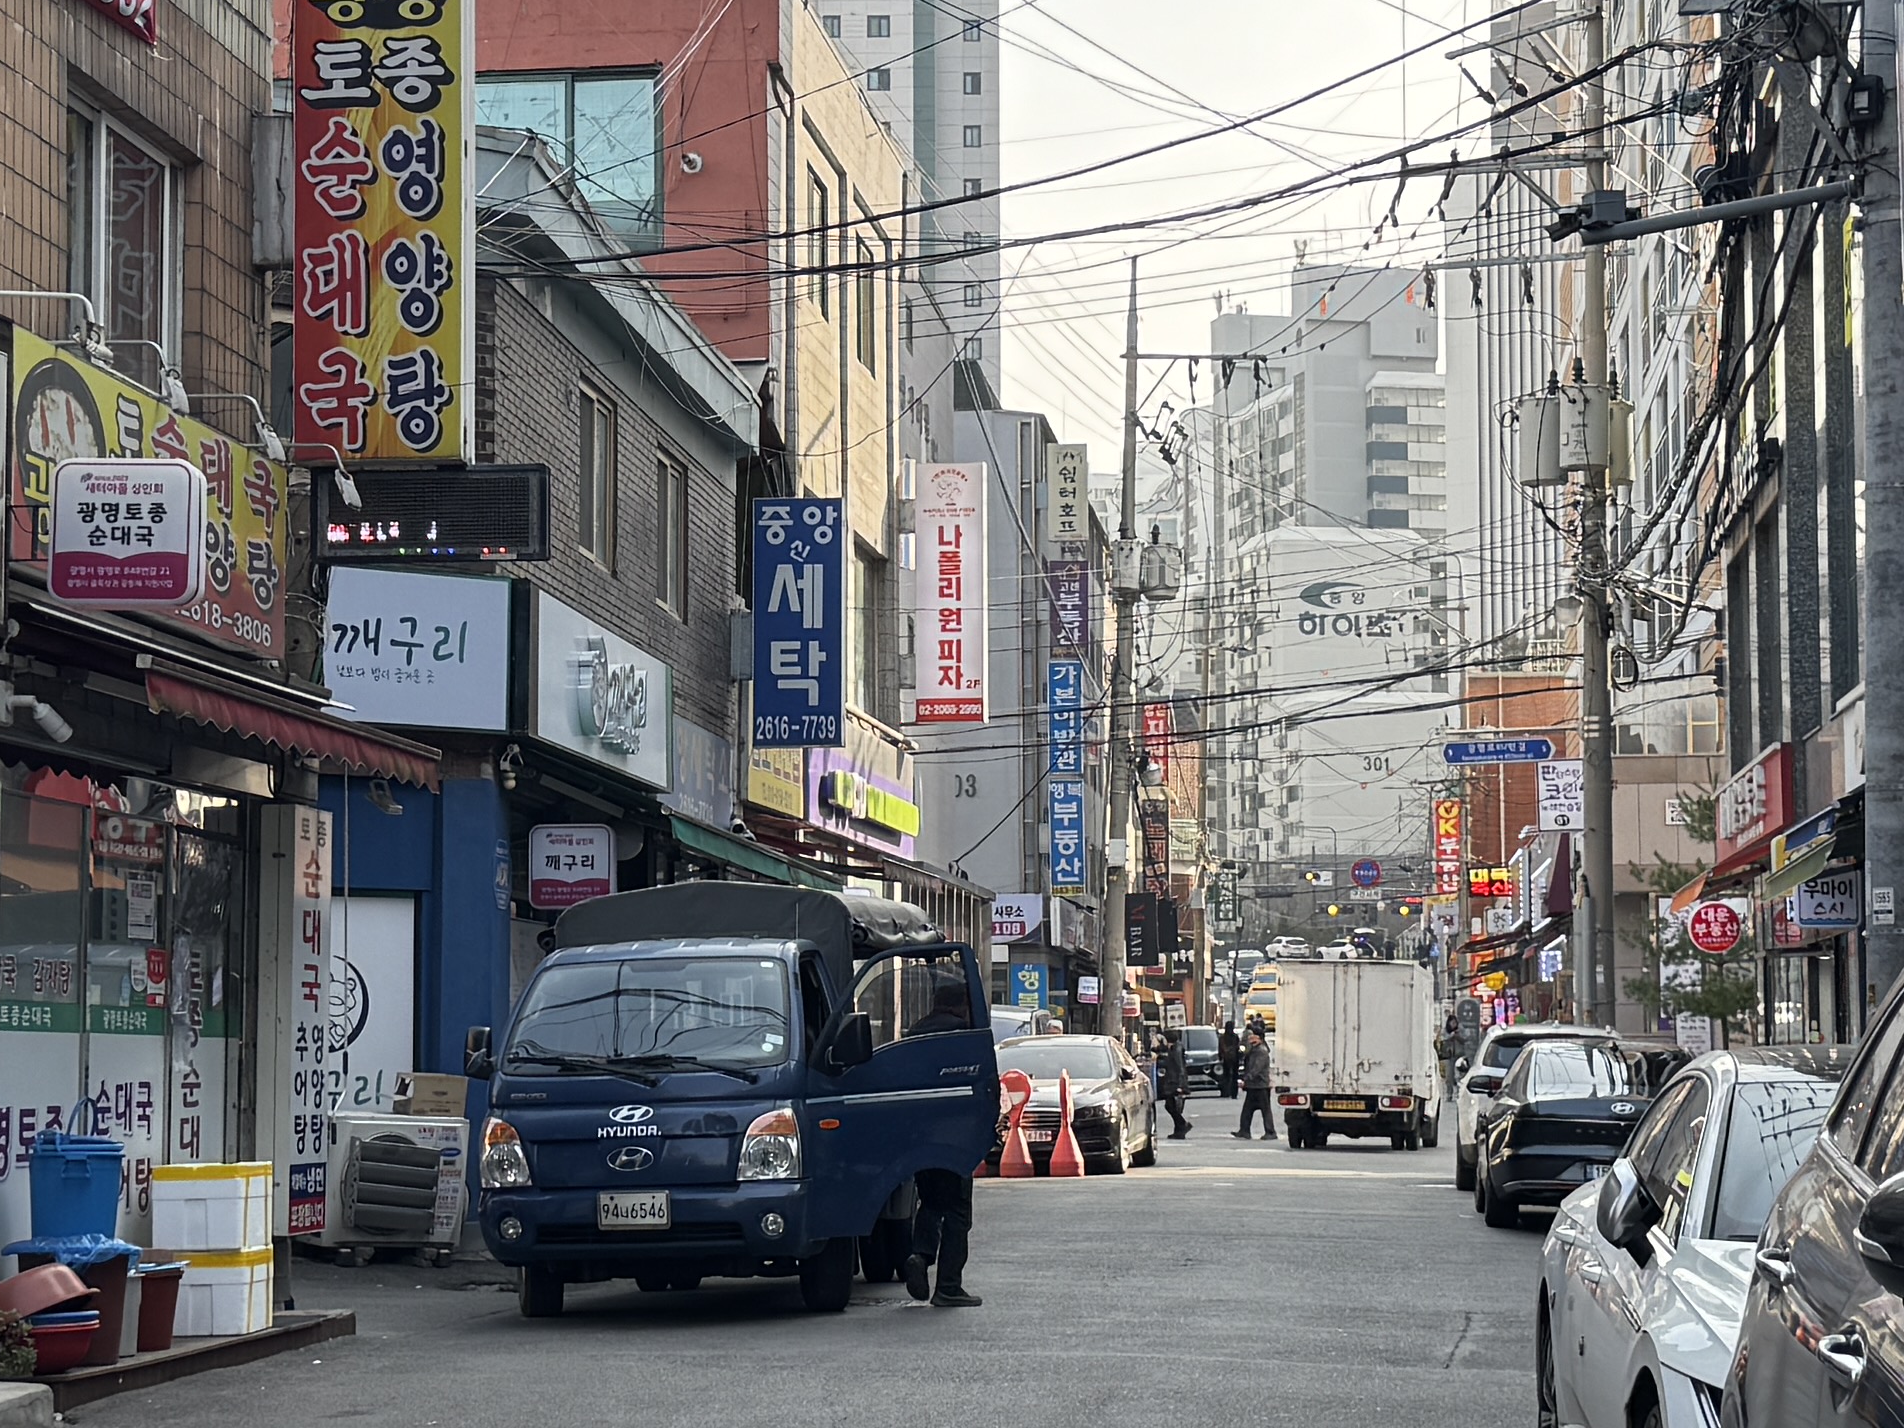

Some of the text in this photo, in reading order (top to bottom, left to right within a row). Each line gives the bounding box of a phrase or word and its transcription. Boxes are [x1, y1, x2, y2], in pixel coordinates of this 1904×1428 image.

[300, 37, 455, 111] 토종
[301, 117, 378, 454] 순대국
[379, 118, 454, 454] 영양탕
[76, 502, 168, 524] 광명토종
[758, 505, 838, 546] 중앙
[87, 525, 155, 548] 순대국
[332, 617, 468, 666] 깨구리
[768, 563, 827, 707] 세탁
[756, 714, 836, 740] 2616-7739
[1362, 756, 1391, 773] 301
[1437, 801, 1460, 835] OK
[1053, 802, 1082, 882] 부동산
[545, 854, 595, 871] 깨구리
[994, 905, 1025, 918] 사무소
[1813, 901, 1845, 916] 스시
[300, 849, 323, 1014] 순대국
[1129, 926, 1143, 957] BAR
[1694, 922, 1739, 938] 부동산
[597, 1125, 662, 1139] HYUNDA
